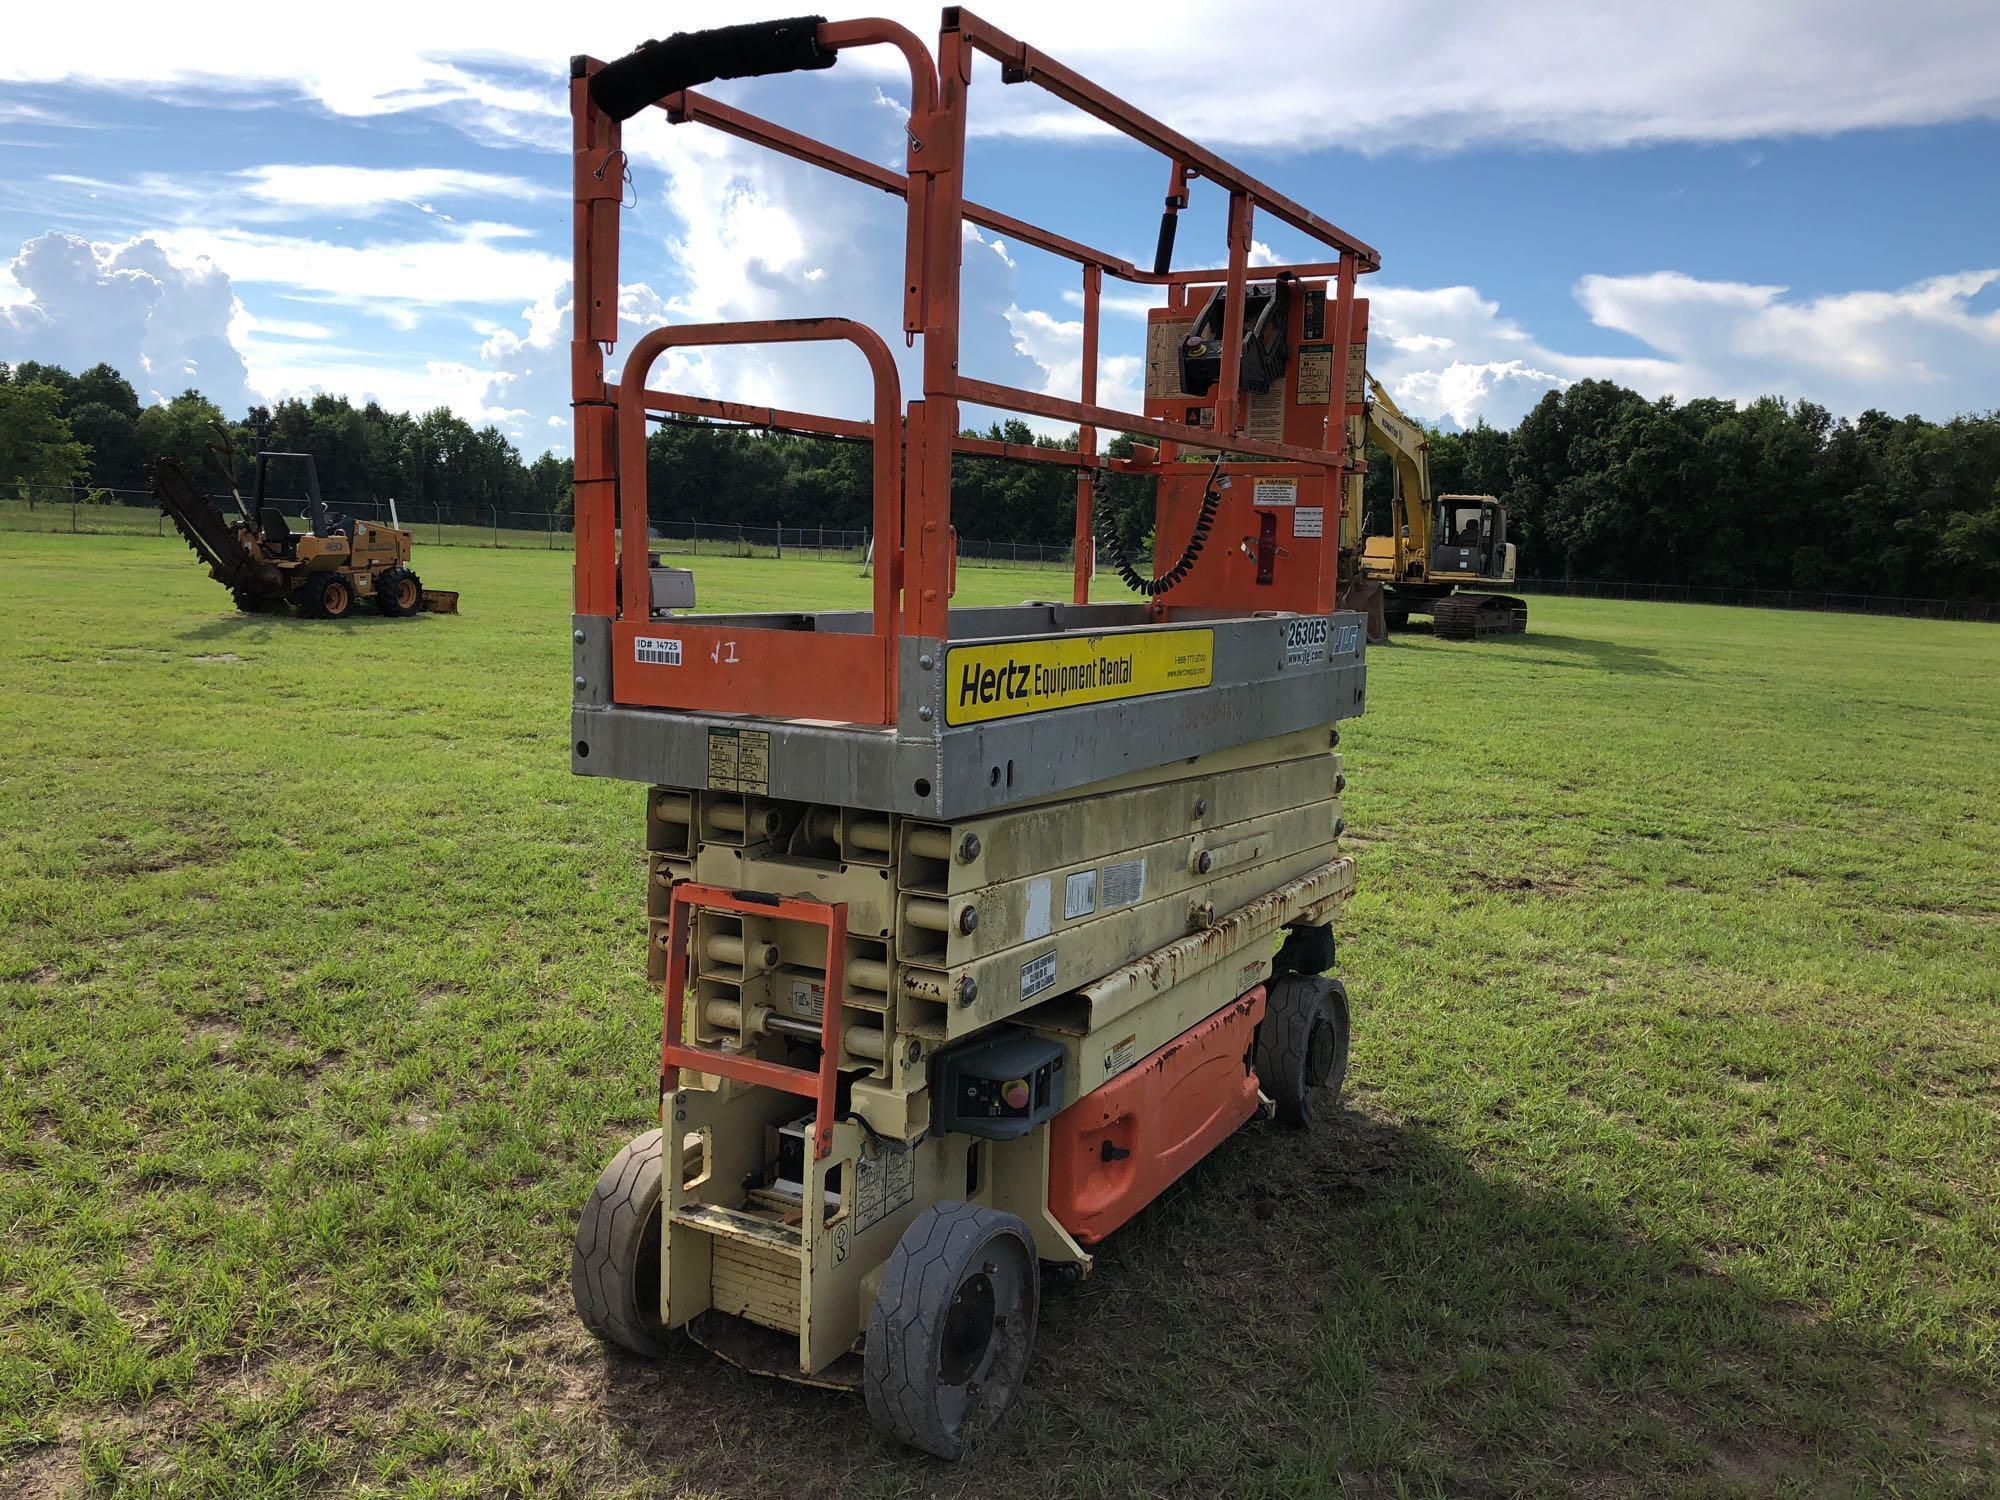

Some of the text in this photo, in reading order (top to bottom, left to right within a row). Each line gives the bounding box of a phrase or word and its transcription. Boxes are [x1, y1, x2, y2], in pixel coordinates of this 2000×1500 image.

[637, 639, 678, 650] ID# 14725
[1287, 619, 1327, 648] 2630ES
[1333, 625, 1358, 654] JLG
[1288, 648, 1323, 665] www.jlg.com
[959, 654, 1133, 707] Hertz Equipment Rental
